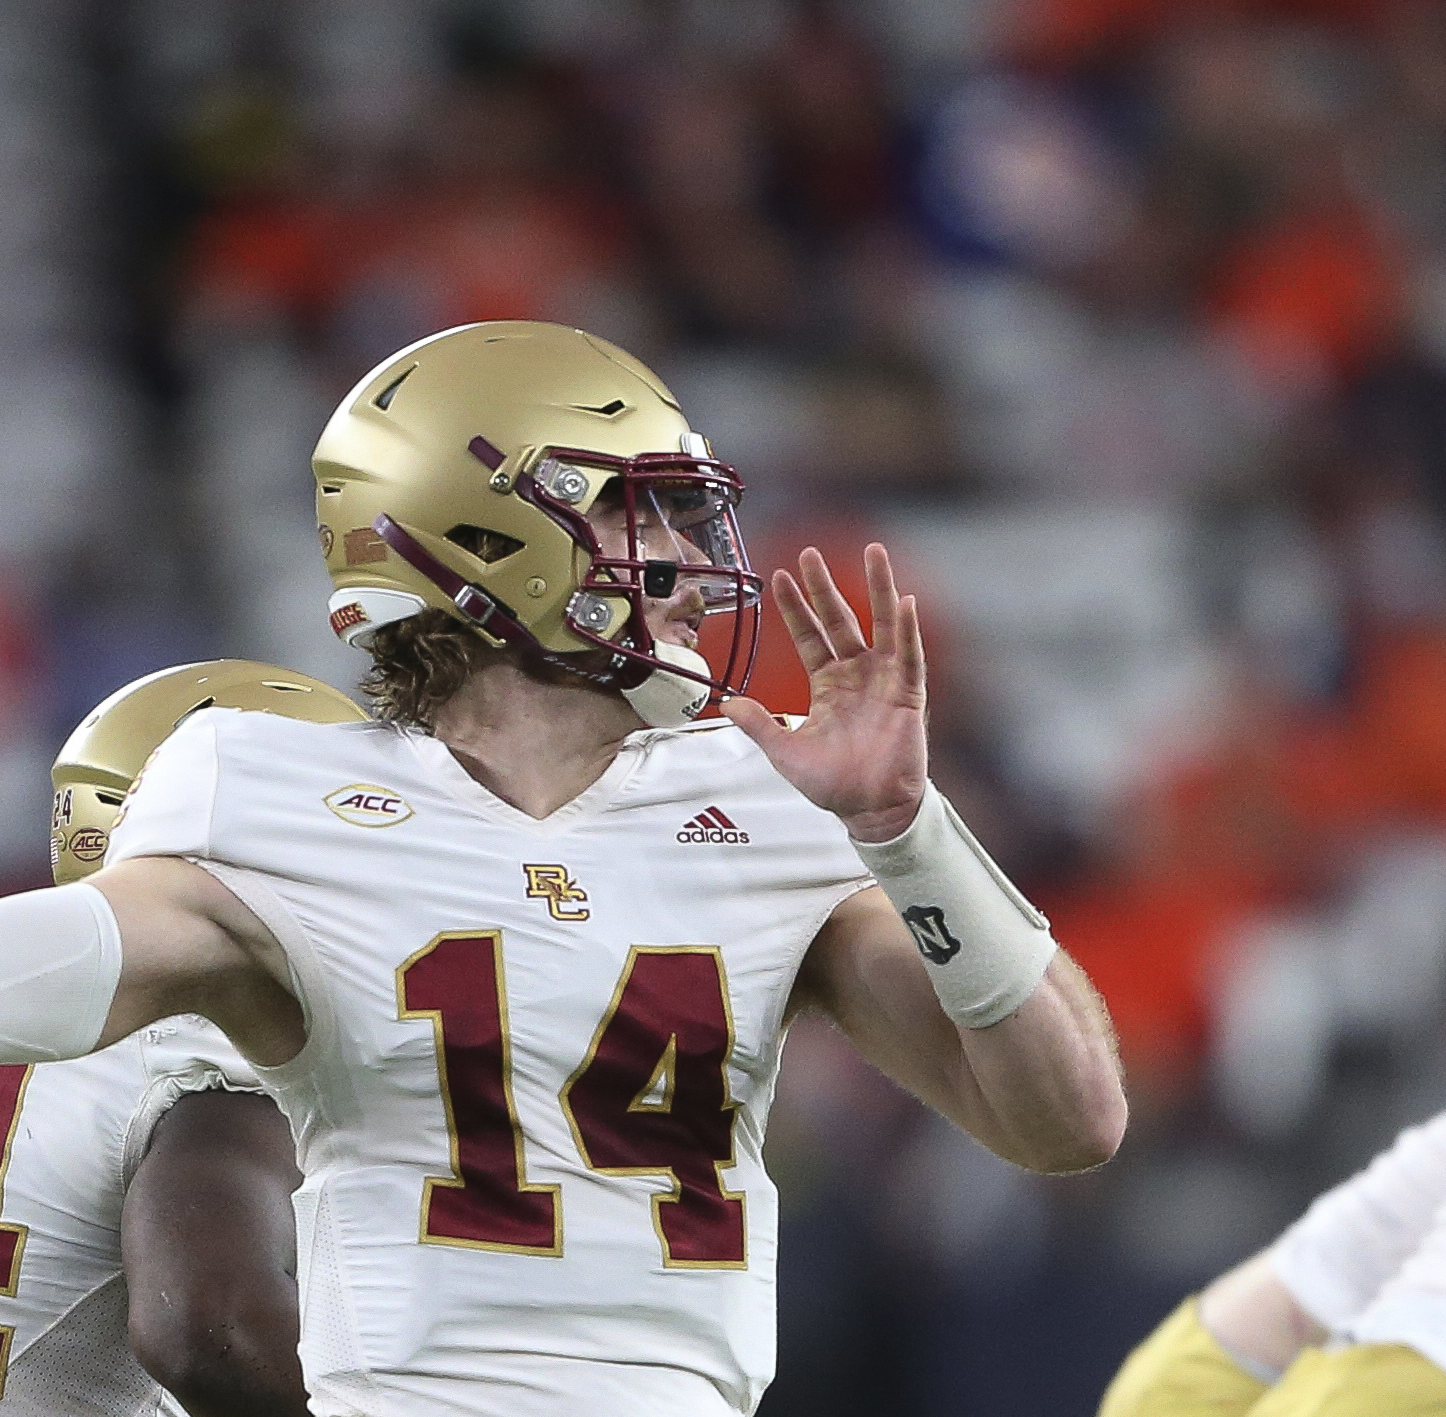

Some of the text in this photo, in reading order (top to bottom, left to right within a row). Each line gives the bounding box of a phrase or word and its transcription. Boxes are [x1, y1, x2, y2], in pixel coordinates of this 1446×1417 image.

[338, 793, 400, 814] ACC
[74, 835, 105, 849] ACC
[676, 828, 751, 845] adidas
[522, 863, 590, 922] BC
[908, 915, 951, 954] N
[395, 929, 749, 1272] 14
